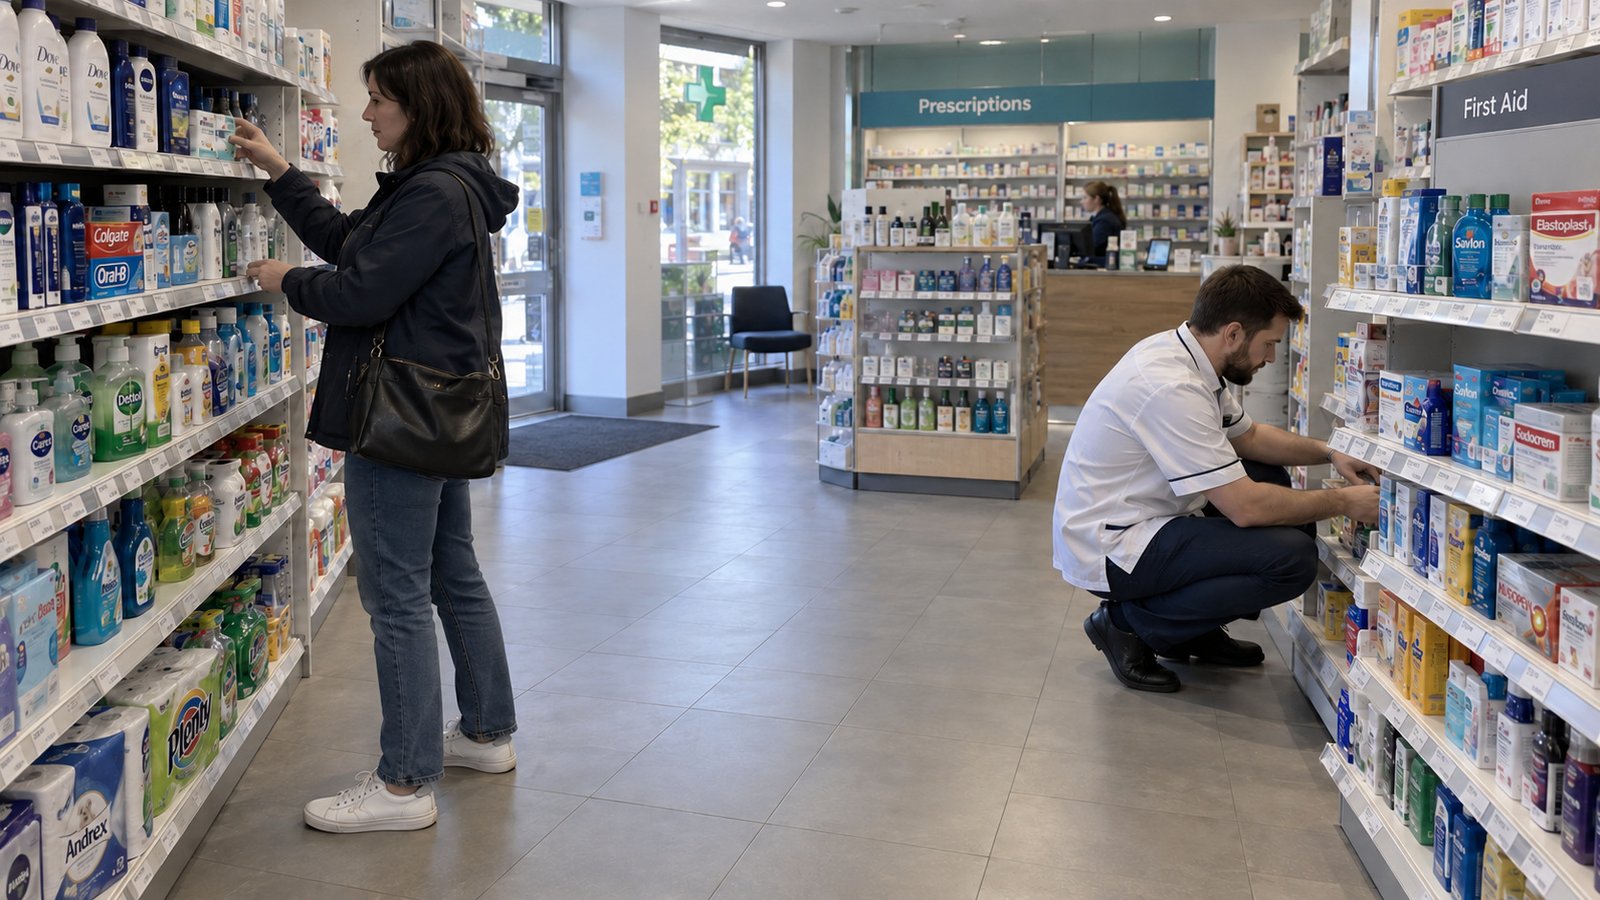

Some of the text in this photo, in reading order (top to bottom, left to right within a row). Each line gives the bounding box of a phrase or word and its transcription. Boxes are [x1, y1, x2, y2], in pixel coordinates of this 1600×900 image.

[37, 46, 60, 65] Dove
[88, 63, 108, 80] Dove
[918, 96, 1032, 116] Prescriptions
[1464, 88, 1529, 119] First Aid
[1536, 218, 1589, 234] Elastoplast
[94, 228, 129, 247] Colgate
[1455, 237, 1486, 249] Savlon
[97, 266, 127, 285] Oral-B
[168, 692, 213, 776] Plenty
[65, 819, 108, 864] Andrex
